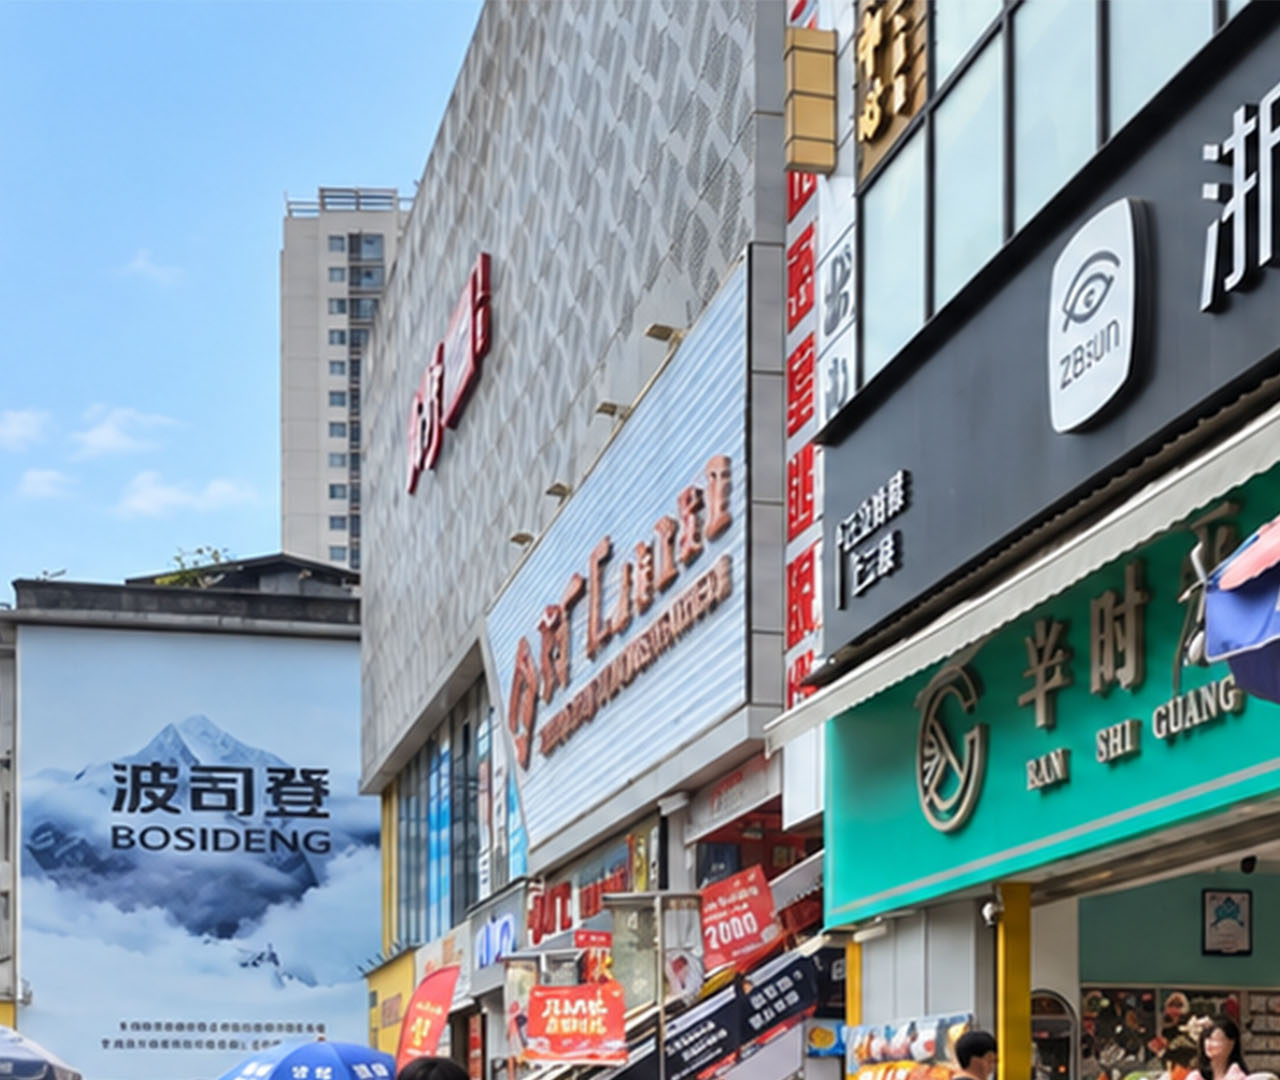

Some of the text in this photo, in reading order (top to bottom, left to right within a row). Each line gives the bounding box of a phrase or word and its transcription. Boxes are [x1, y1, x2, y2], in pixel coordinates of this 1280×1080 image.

[1097, 721, 1135, 763] SHI
[1153, 675, 1237, 739] GUANG
[111, 761, 330, 819] 波司登
[111, 825, 332, 854] BOSIDENG
